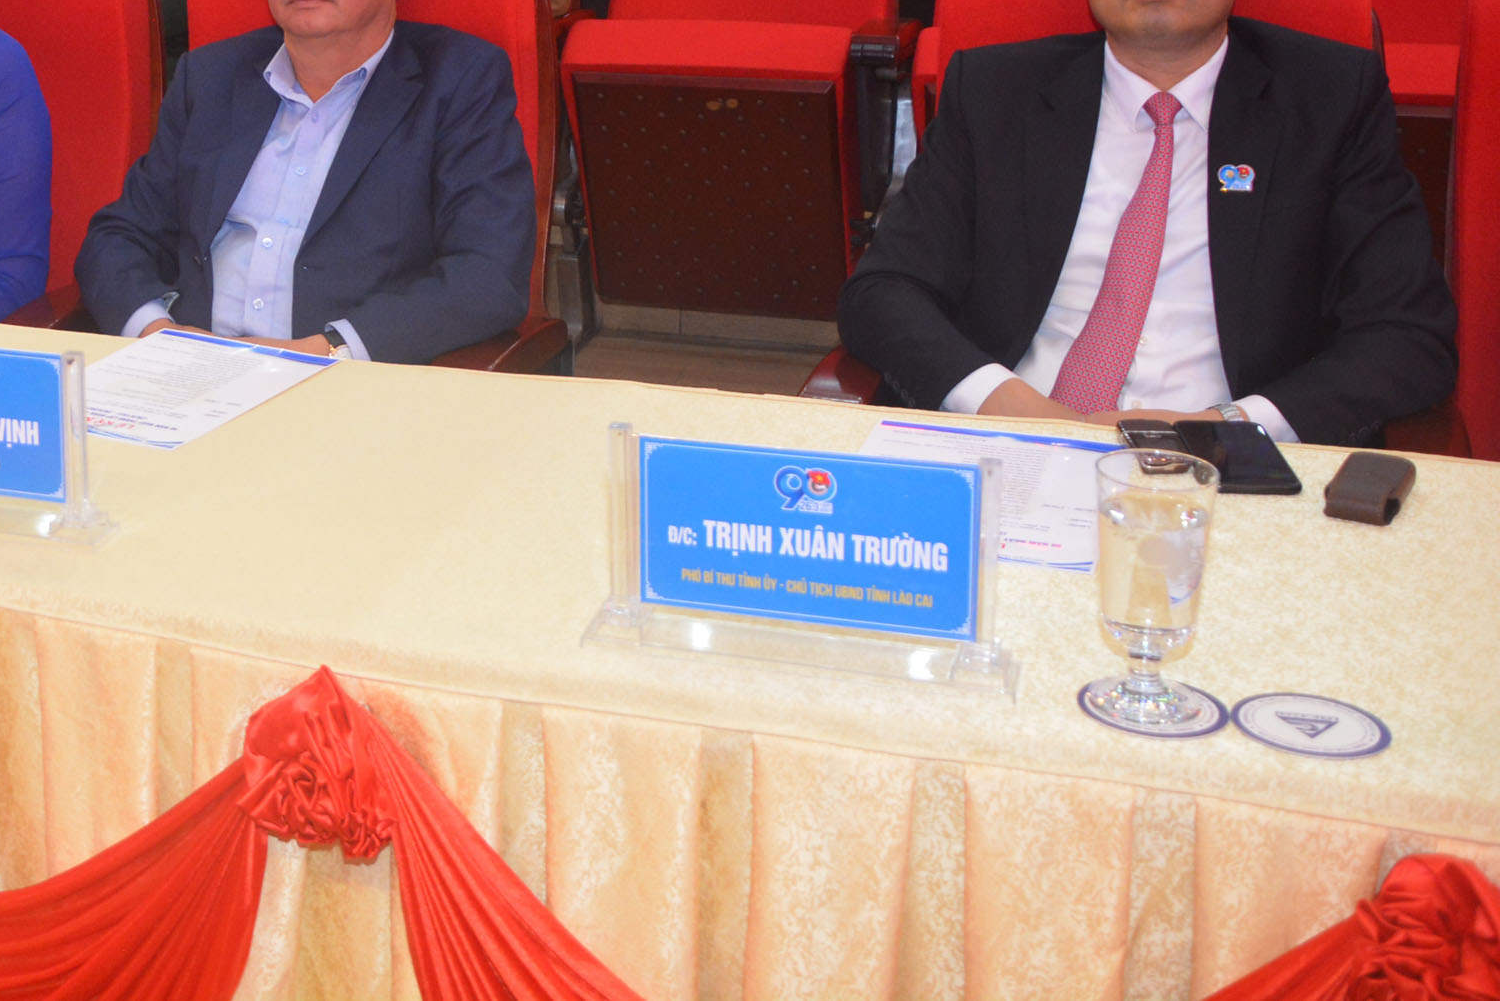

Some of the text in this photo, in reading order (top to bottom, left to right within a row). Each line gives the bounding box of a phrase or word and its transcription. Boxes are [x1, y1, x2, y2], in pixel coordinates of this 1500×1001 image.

[667, 519, 949, 572] Đ/C: TRỊNH XUÂN TRƯỜNG
[681, 567, 701, 583] PHÓ
[703, 568, 714, 584] BÍ
[716, 571, 736, 587] THƯ
[738, 570, 762, 590] TỈNH
[763, 573, 778, 591] ỦY
[786, 577, 808, 594] CHỦ
[810, 581, 833, 598] TỊCH
[835, 584, 864, 601] UBND
[866, 584, 891, 604] TỈNH
[893, 589, 914, 606] LÀO
[915, 593, 934, 608] CAI
